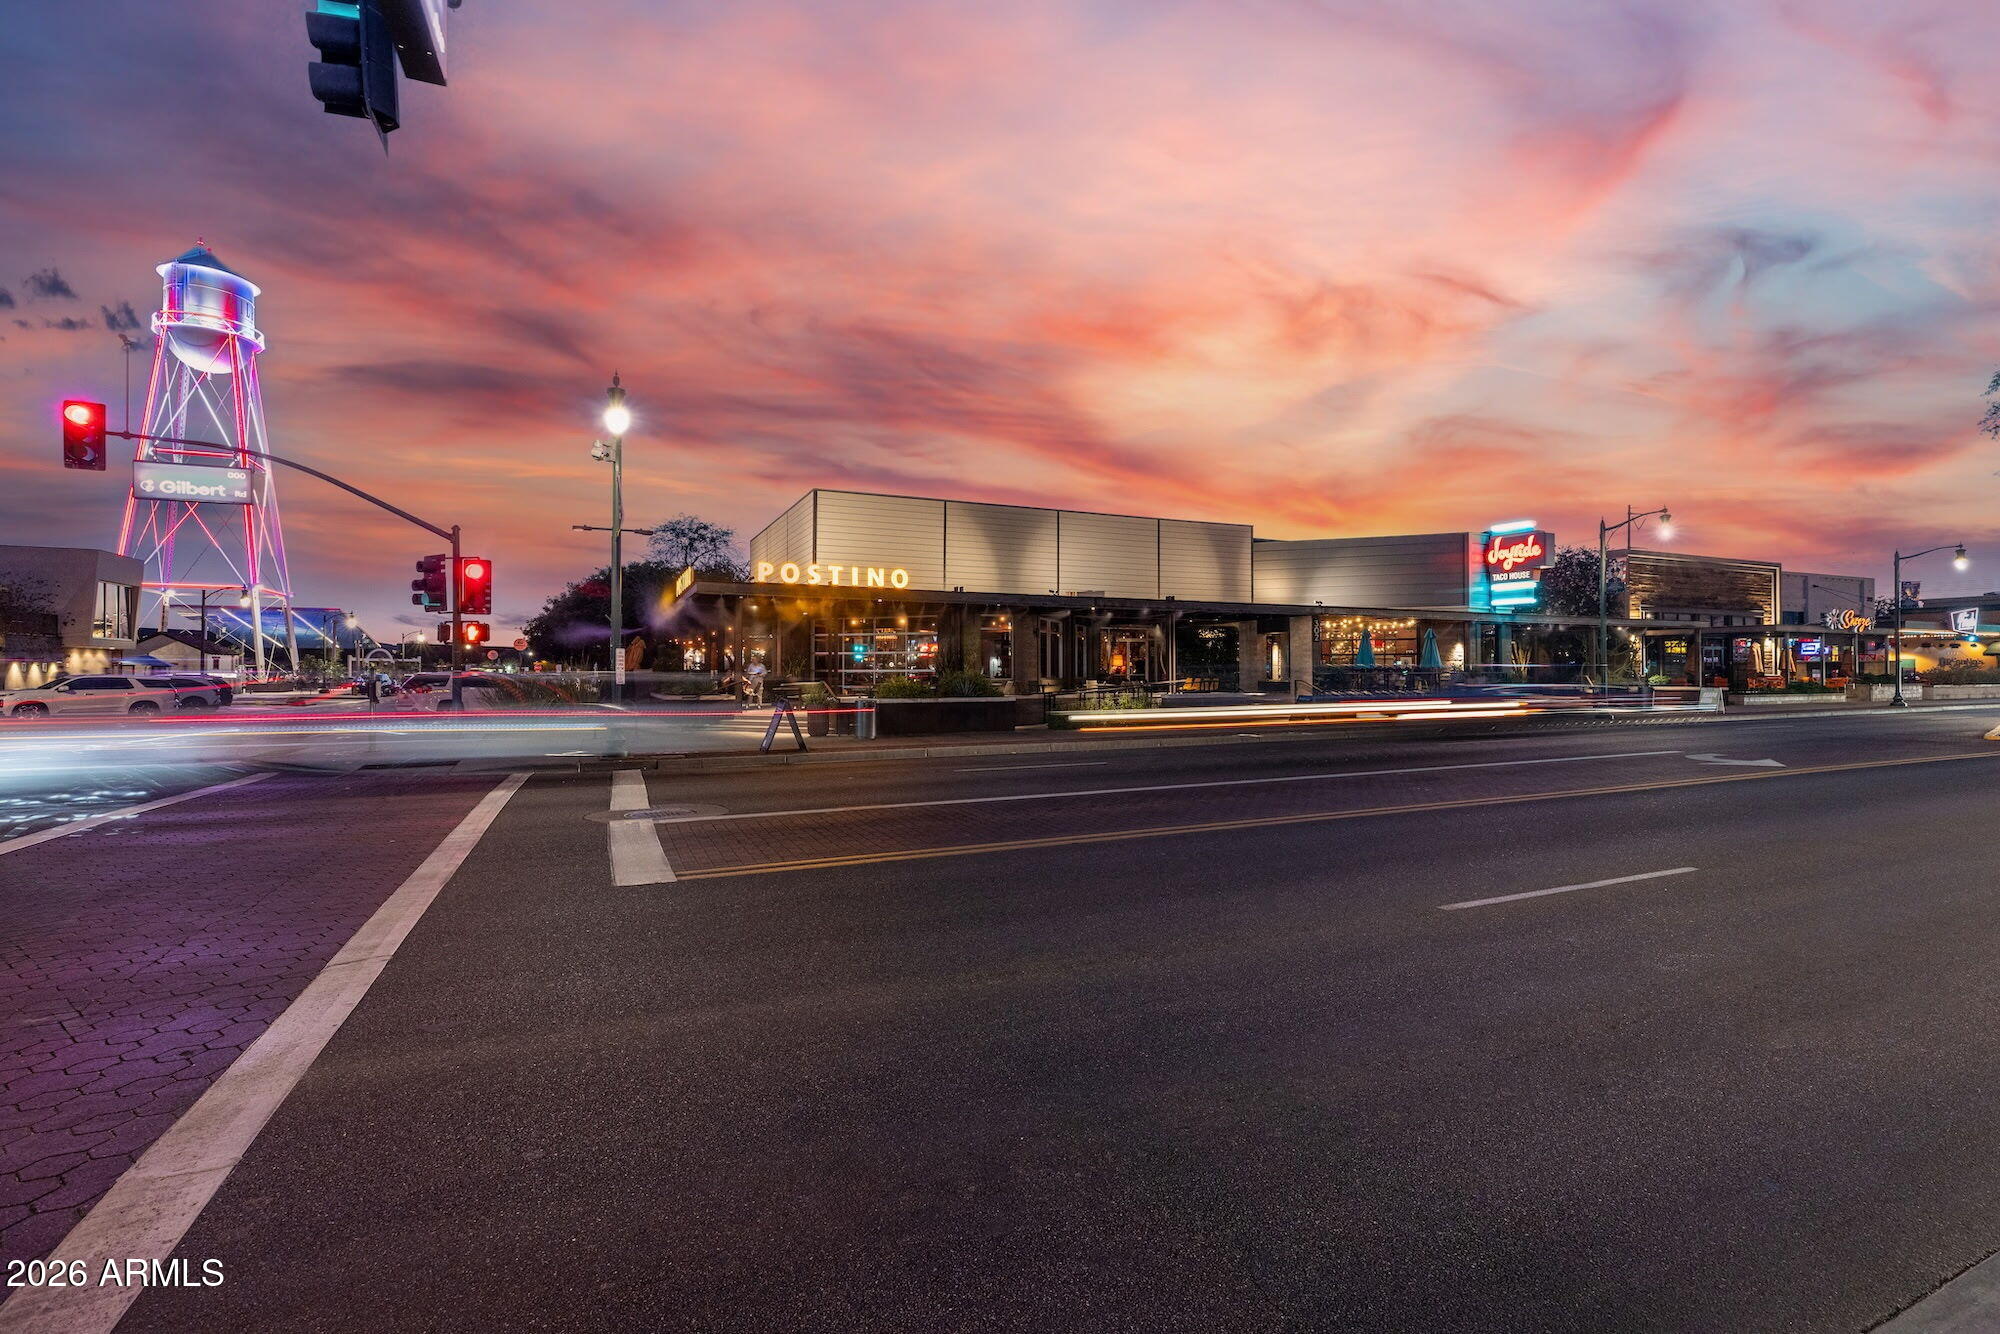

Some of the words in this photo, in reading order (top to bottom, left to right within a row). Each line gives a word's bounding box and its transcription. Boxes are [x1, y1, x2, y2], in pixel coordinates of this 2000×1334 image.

[159, 480, 226, 497] Gilbert
[757, 561, 909, 589] POSTINO
[1492, 573, 1508, 581] TACO
[1509, 571, 1530, 580] HOUSE
